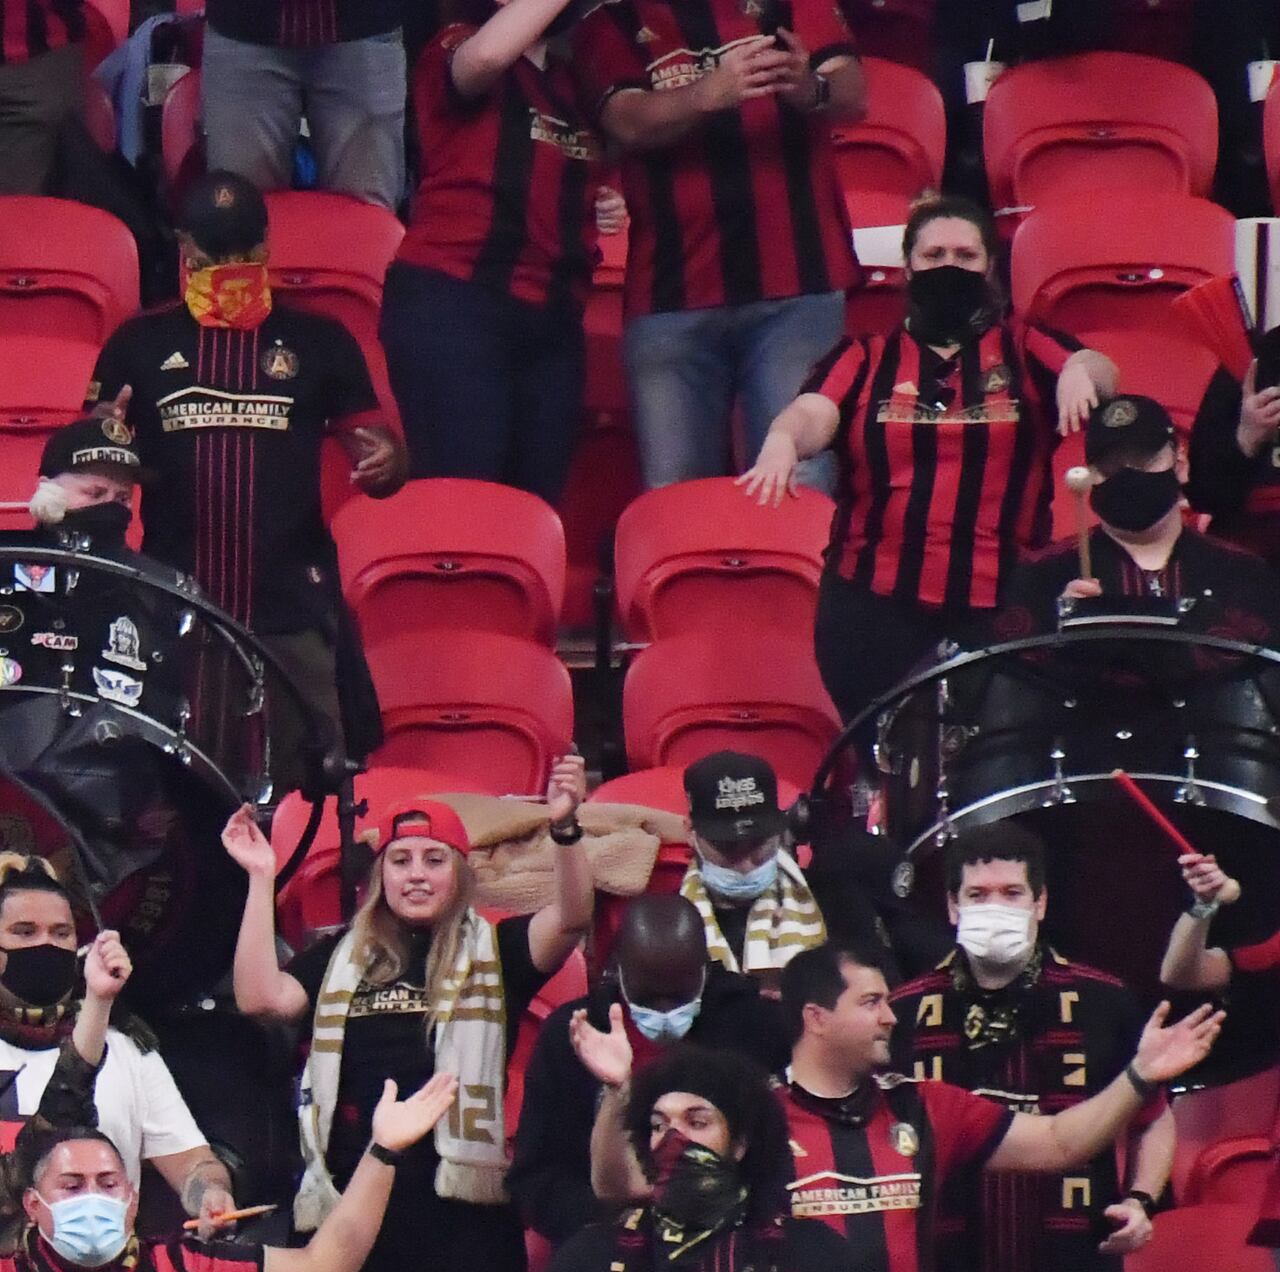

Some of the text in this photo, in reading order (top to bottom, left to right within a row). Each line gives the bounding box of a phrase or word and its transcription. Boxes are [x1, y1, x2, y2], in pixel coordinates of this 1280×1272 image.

[161, 402, 291, 418] AMERICAN FAMILY
[792, 1181, 920, 1204] AMERICAN FAMILY
